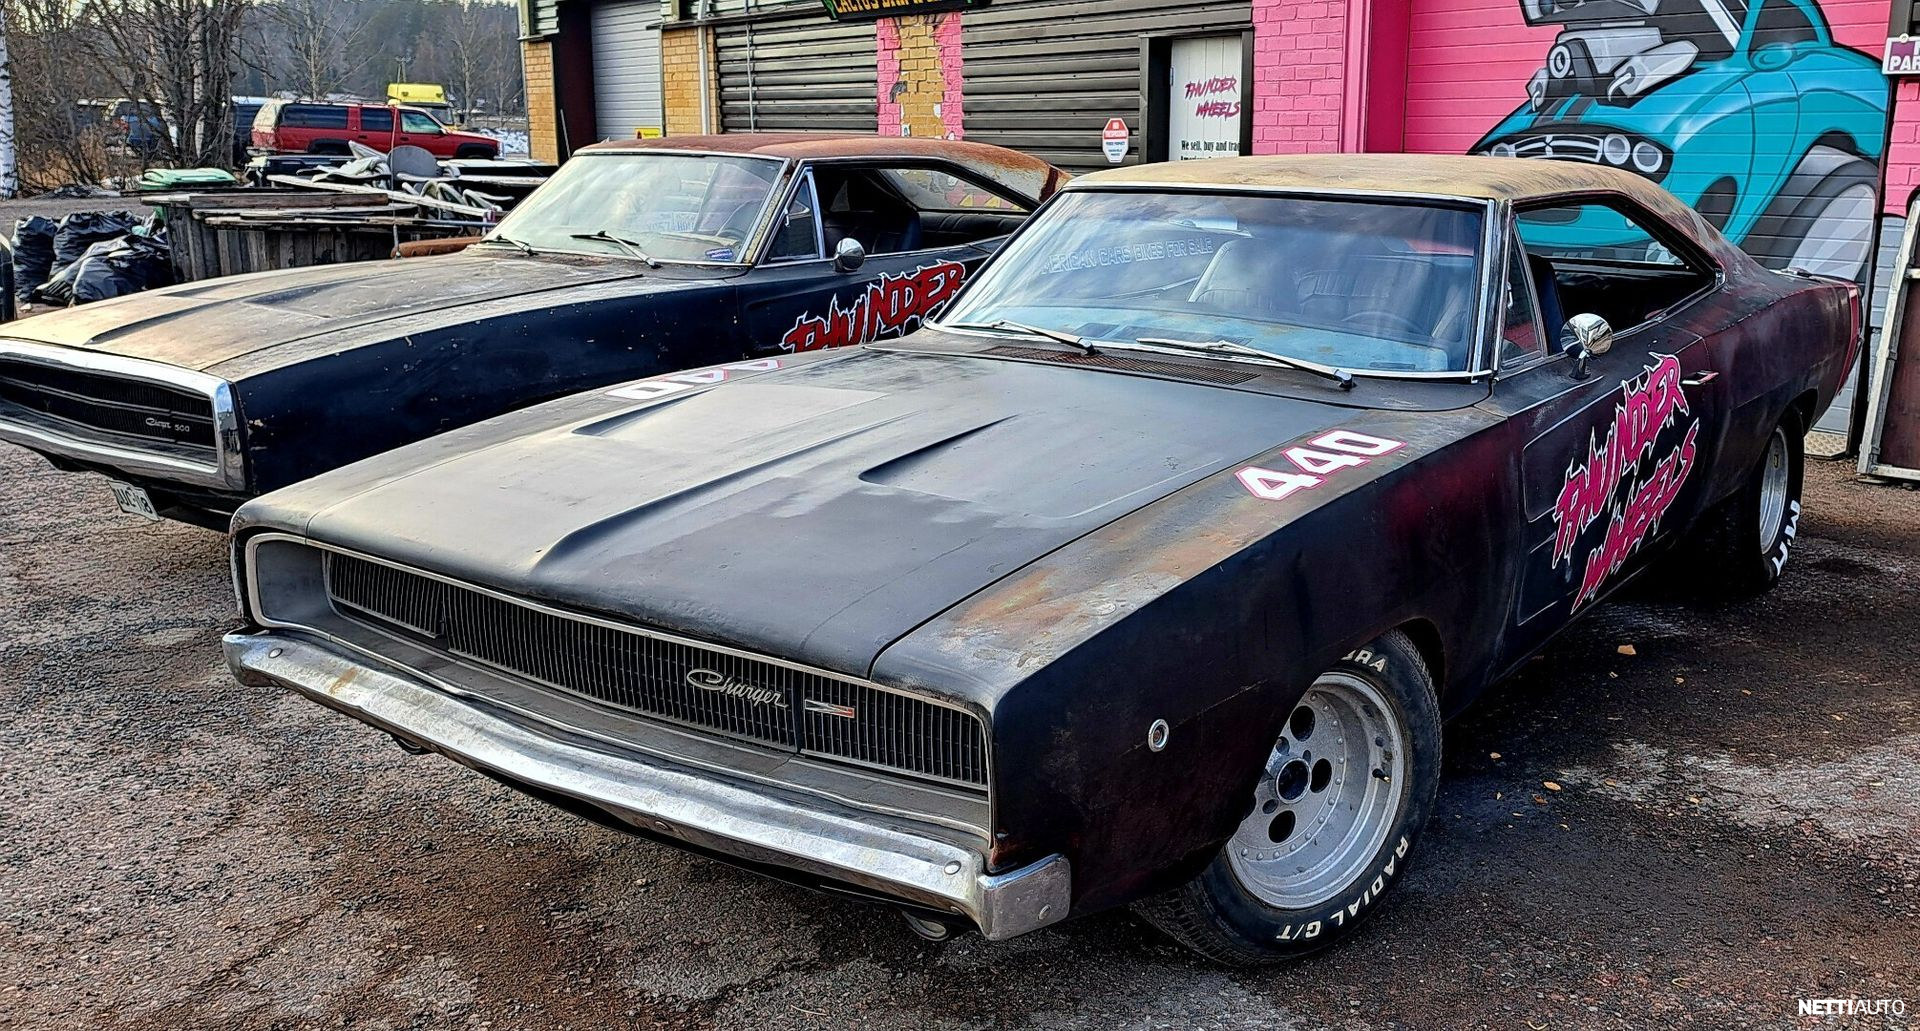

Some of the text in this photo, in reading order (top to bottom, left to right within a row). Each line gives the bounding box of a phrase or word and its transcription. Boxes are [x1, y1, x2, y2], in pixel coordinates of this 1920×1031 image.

[1185, 75, 1237, 100] THUNDER
[1196, 99, 1240, 121] WHEELS
[1181, 140, 1189, 150] We
[1204, 141, 1214, 152] buy
[1216, 141, 1227, 151] and
[1100, 246, 1131, 266] CARS
[1133, 241, 1165, 261] BIKES
[1166, 239, 1188, 257] FOR
[1234, 428, 1408, 500] 440
[1552, 352, 1689, 569] THUNDER
[1571, 418, 1699, 614] WHEELS
[686, 668, 789, 708] Charger
[1328, 836, 1409, 926] RADIAL
